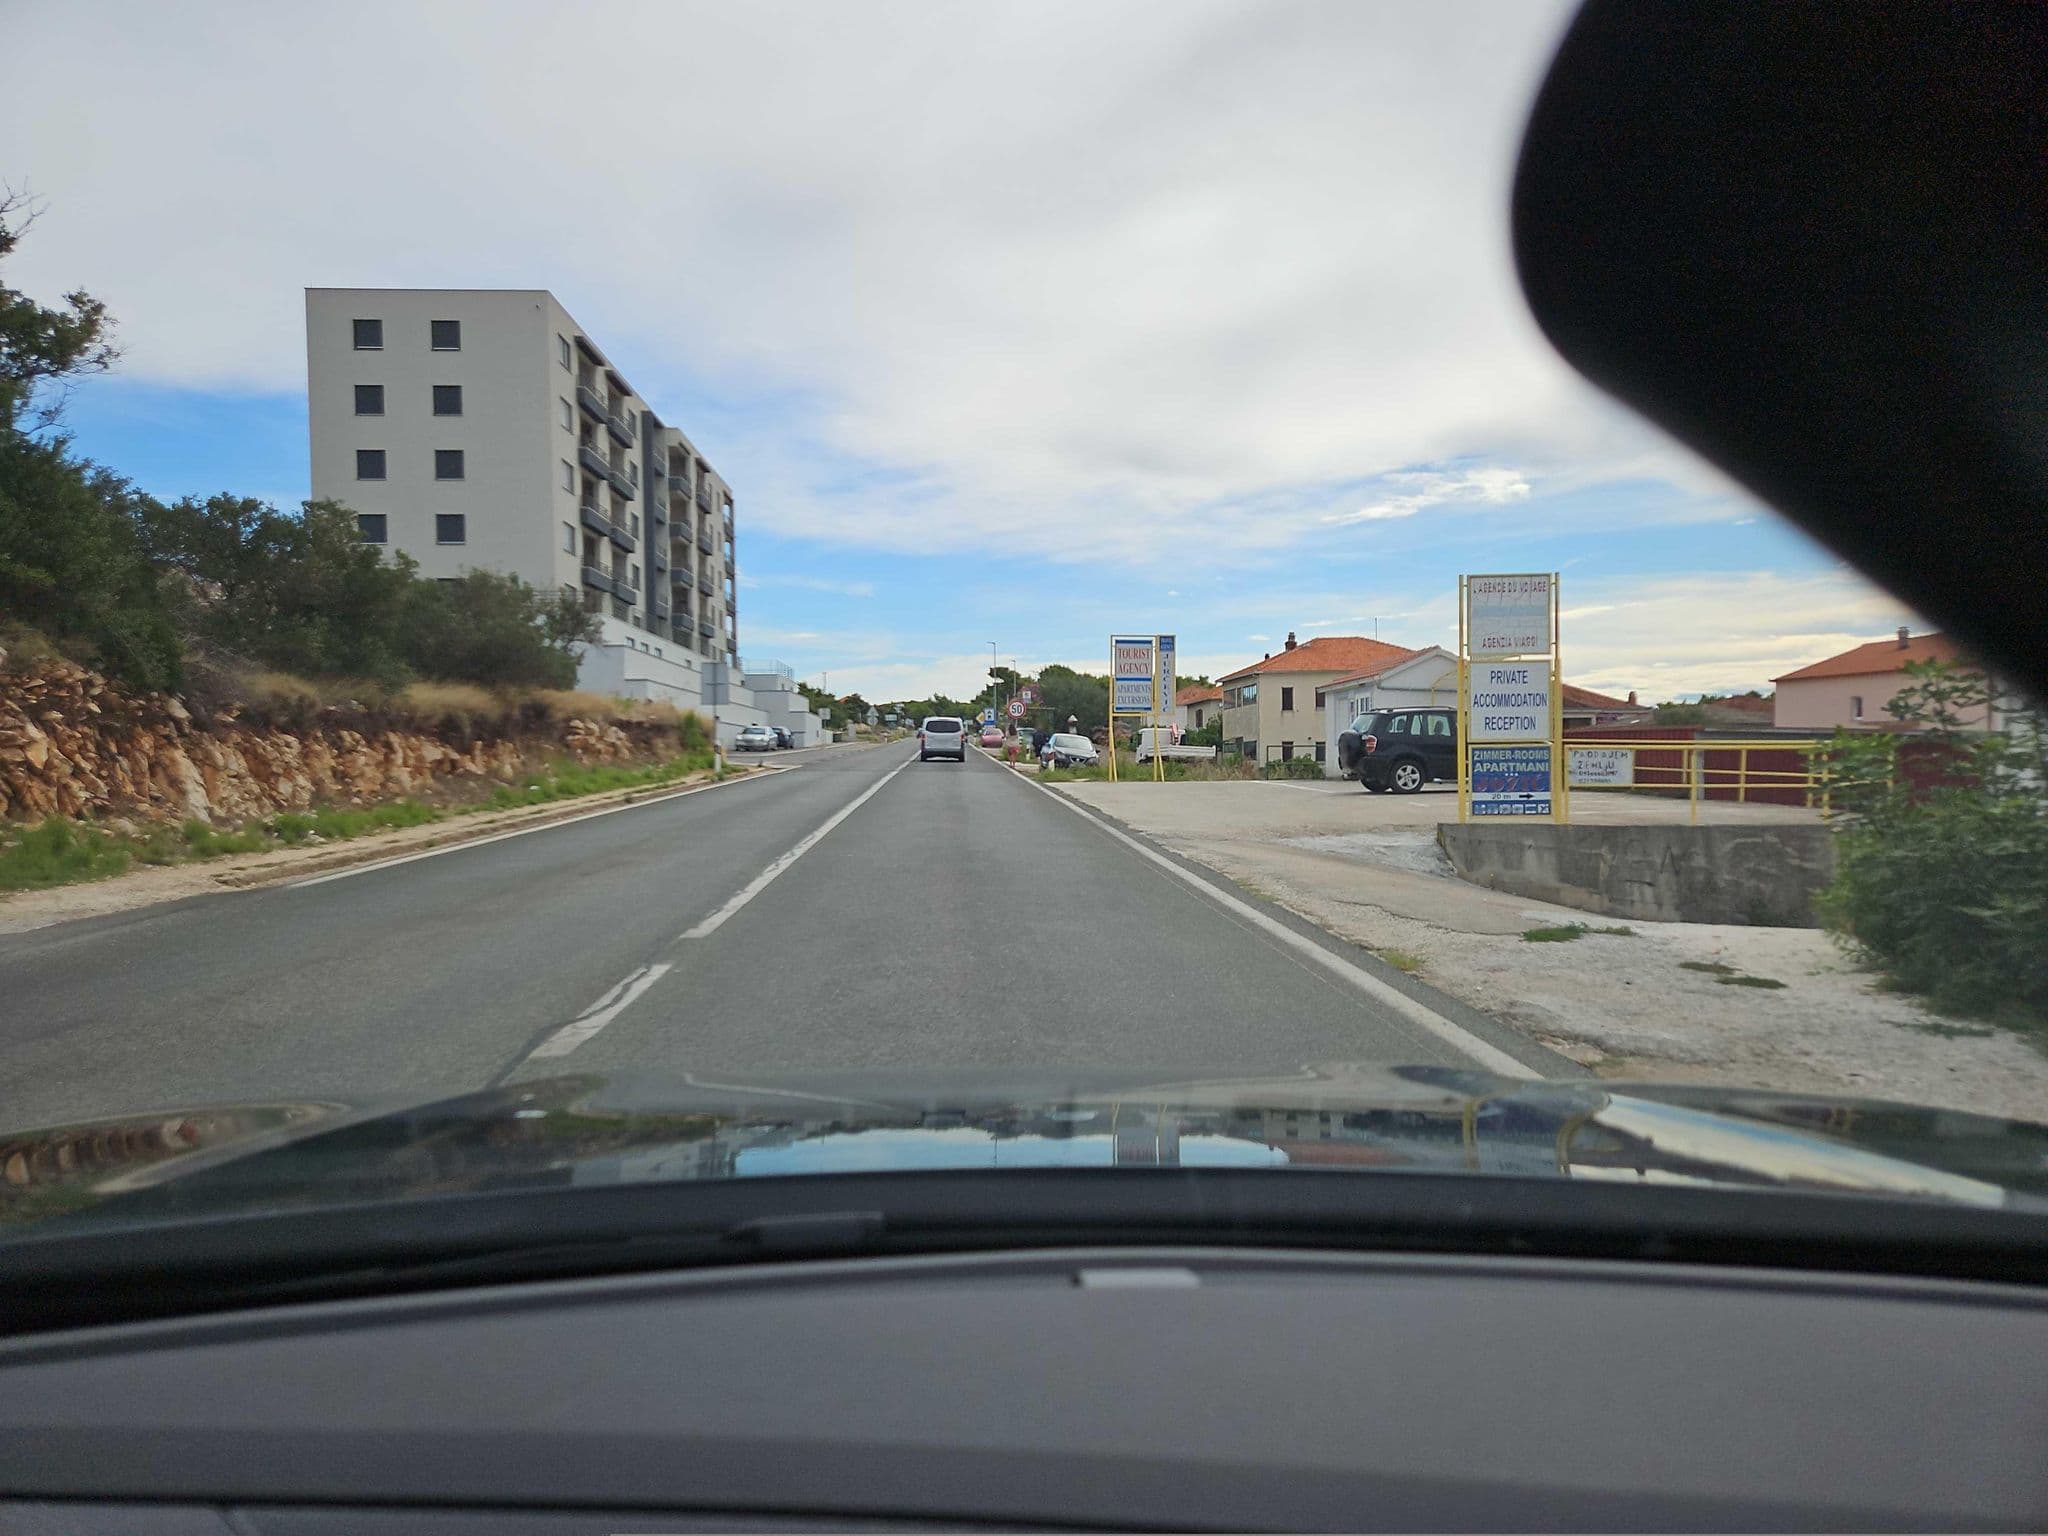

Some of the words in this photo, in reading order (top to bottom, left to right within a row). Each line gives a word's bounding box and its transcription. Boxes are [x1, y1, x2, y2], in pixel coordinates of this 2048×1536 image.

[1118, 647, 1151, 660] TOURIST
[1119, 663, 1150, 674] AGENCY
[1490, 670, 1529, 684] PRIVATE
[1117, 684, 1152, 693] APARTMENTS
[1473, 693, 1548, 708] ACCOMMODATION
[1011, 704, 1023, 714] 50
[1484, 716, 1537, 731] RECEPTION
[1474, 750, 1550, 761] ZIMMER-ROOMS
[1474, 762, 1550, 772] APARTMANI
